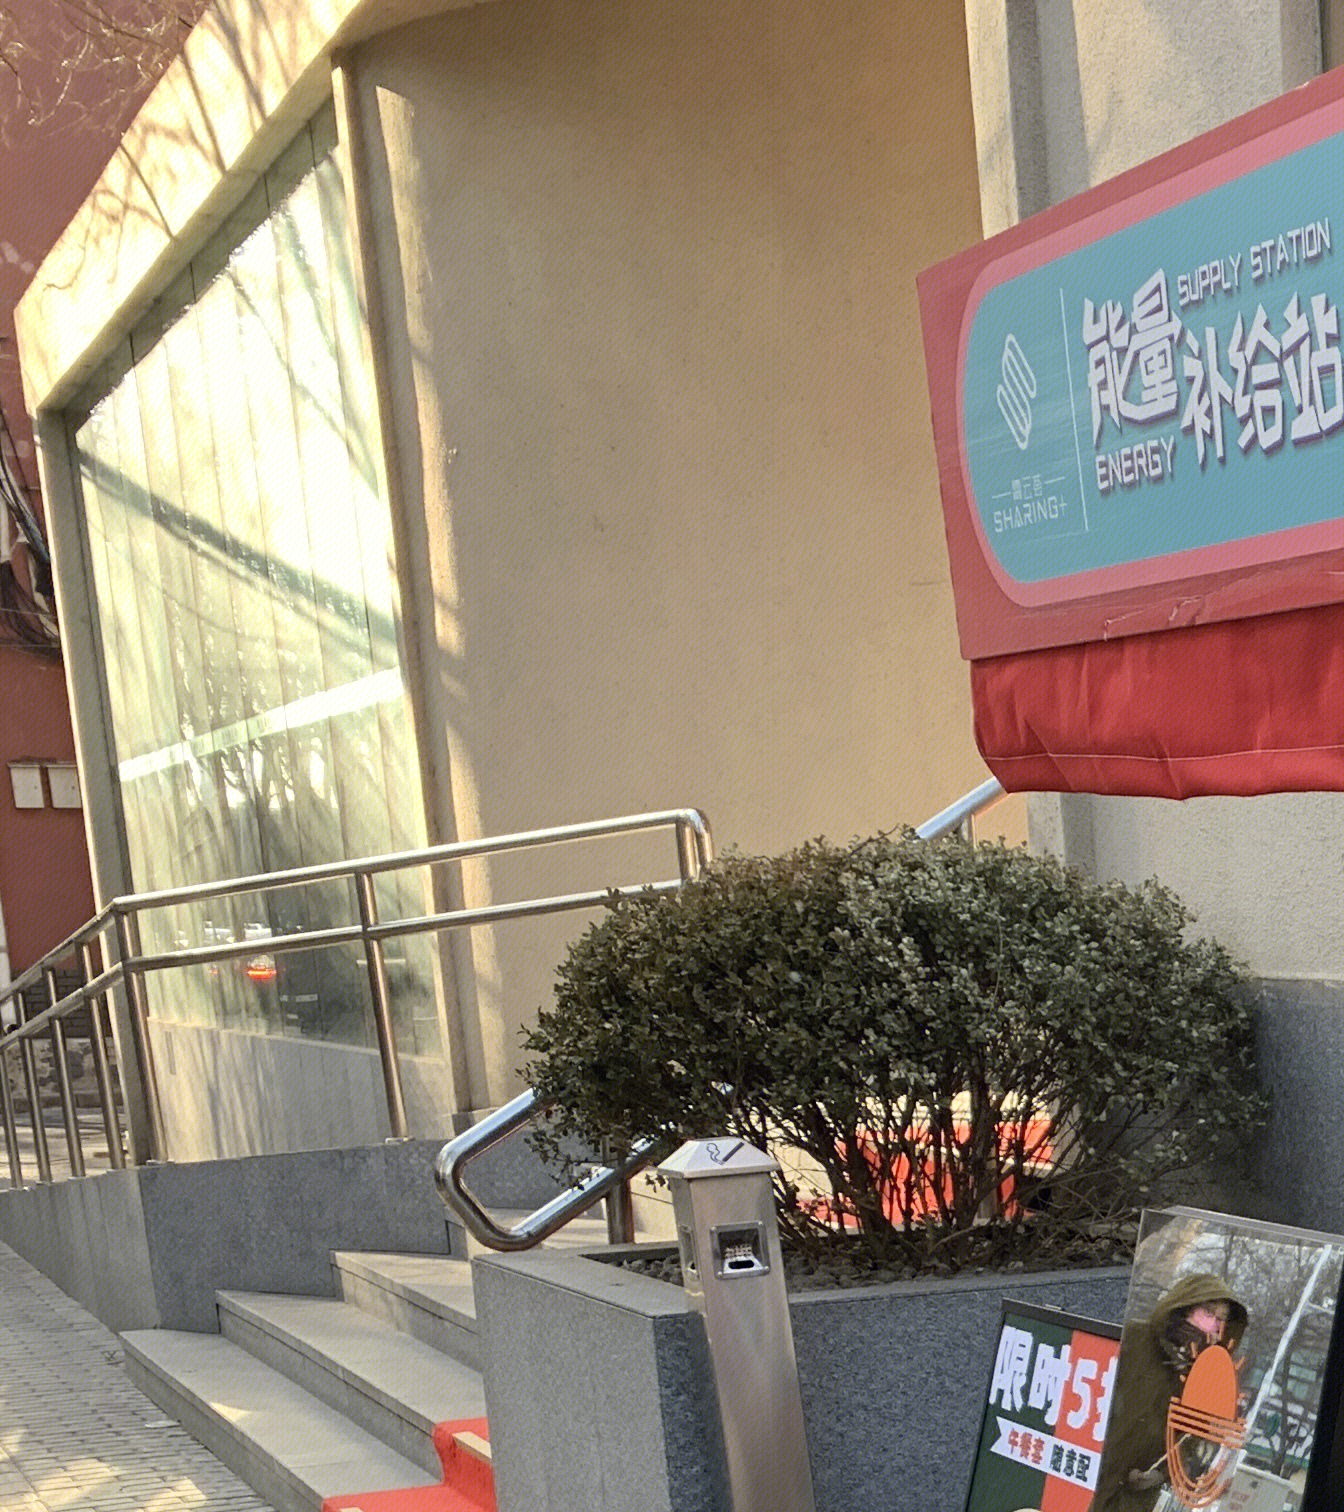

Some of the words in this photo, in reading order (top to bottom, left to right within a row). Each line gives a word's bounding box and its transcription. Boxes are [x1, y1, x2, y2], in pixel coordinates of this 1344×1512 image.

[1177, 253, 1241, 307] SUPPLY
[1250, 217, 1331, 279] STATION
[1083, 268, 1344, 465] 能量补给站
[1096, 435, 1175, 490] ENERGY
